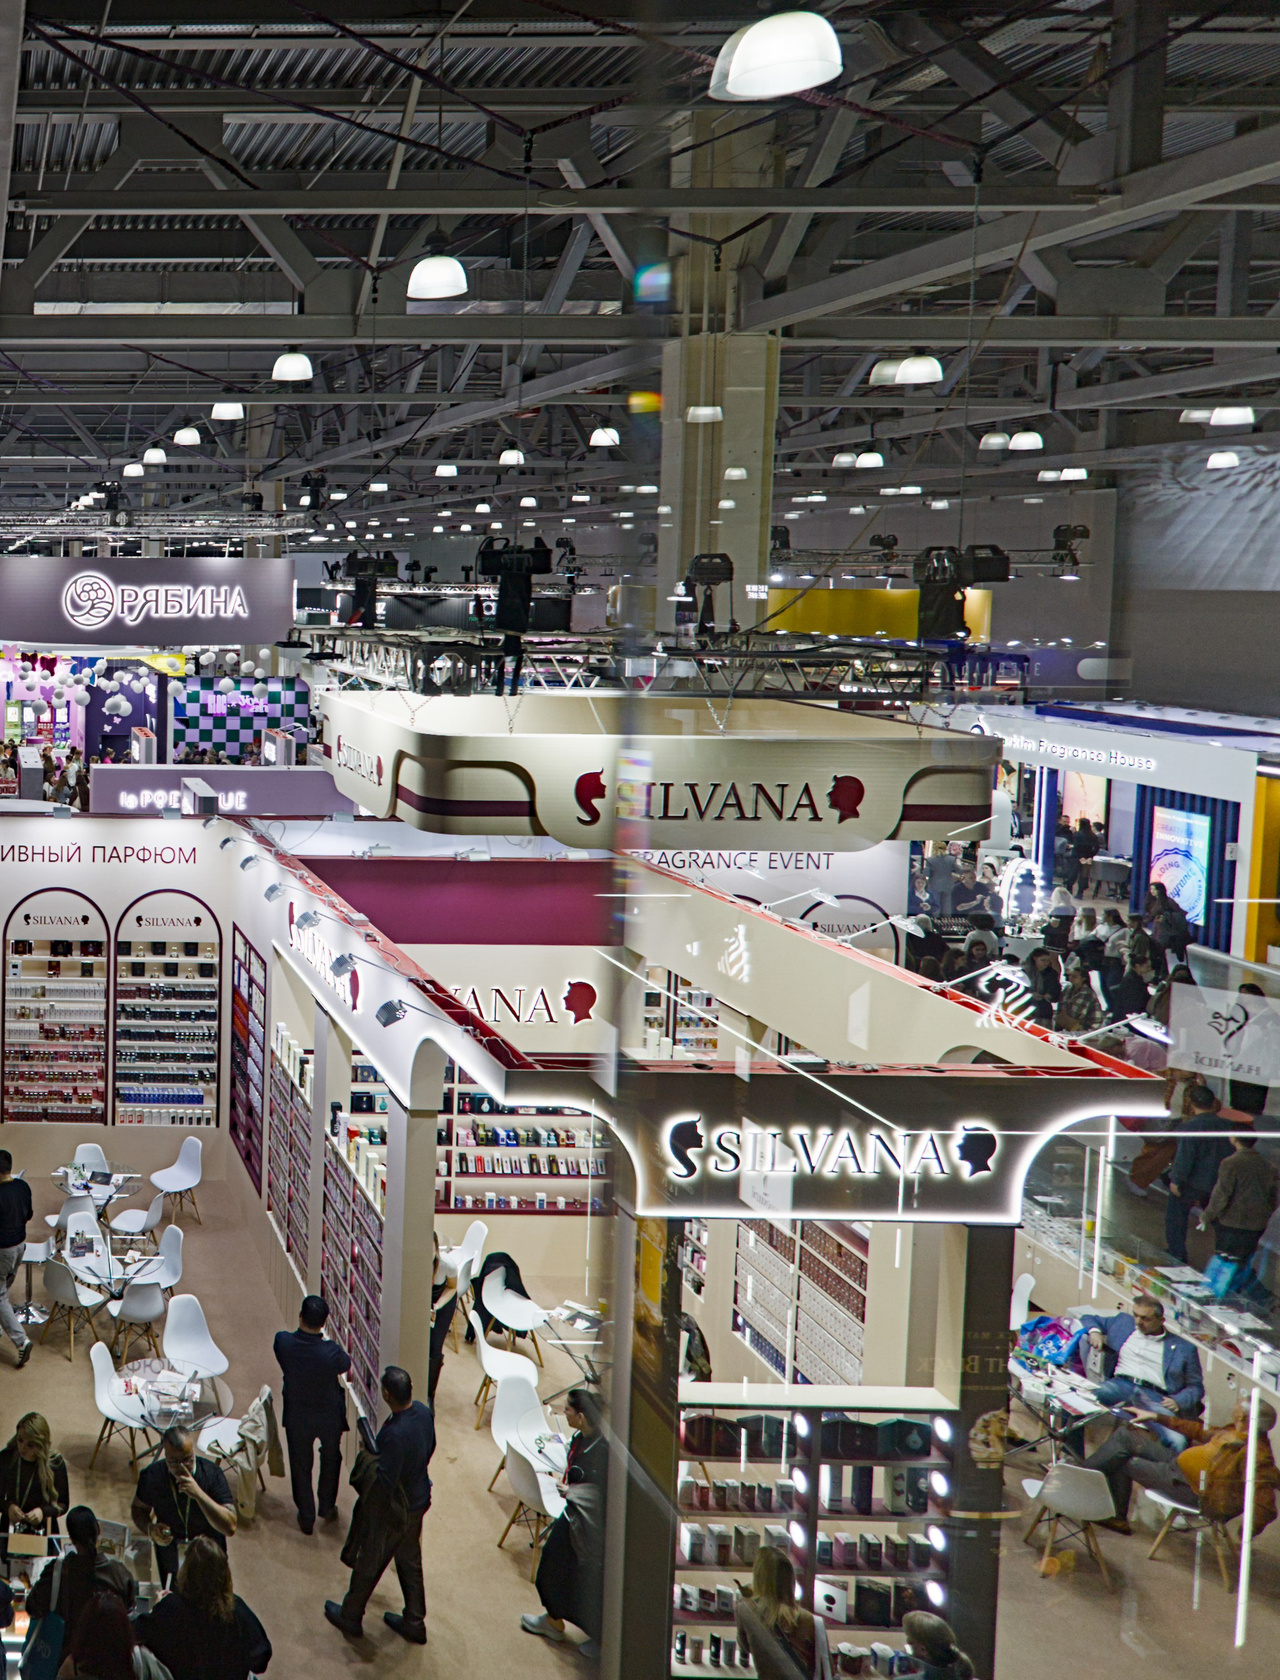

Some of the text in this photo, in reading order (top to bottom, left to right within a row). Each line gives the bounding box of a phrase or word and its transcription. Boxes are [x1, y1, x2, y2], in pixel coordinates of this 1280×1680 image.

[120, 586, 249, 622] РЯБИНА
[1038, 738, 1105, 762] Fragrance
[1108, 751, 1155, 771] House
[92, 845, 197, 864] ПАРФЮМ
[768, 852, 835, 870] EVENT
[32, 915, 80, 926] SILVANA
[145, 916, 192, 928] SILVANA
[820, 923, 869, 934] SILVANA
[714, 1131, 950, 1175] SILVANA
